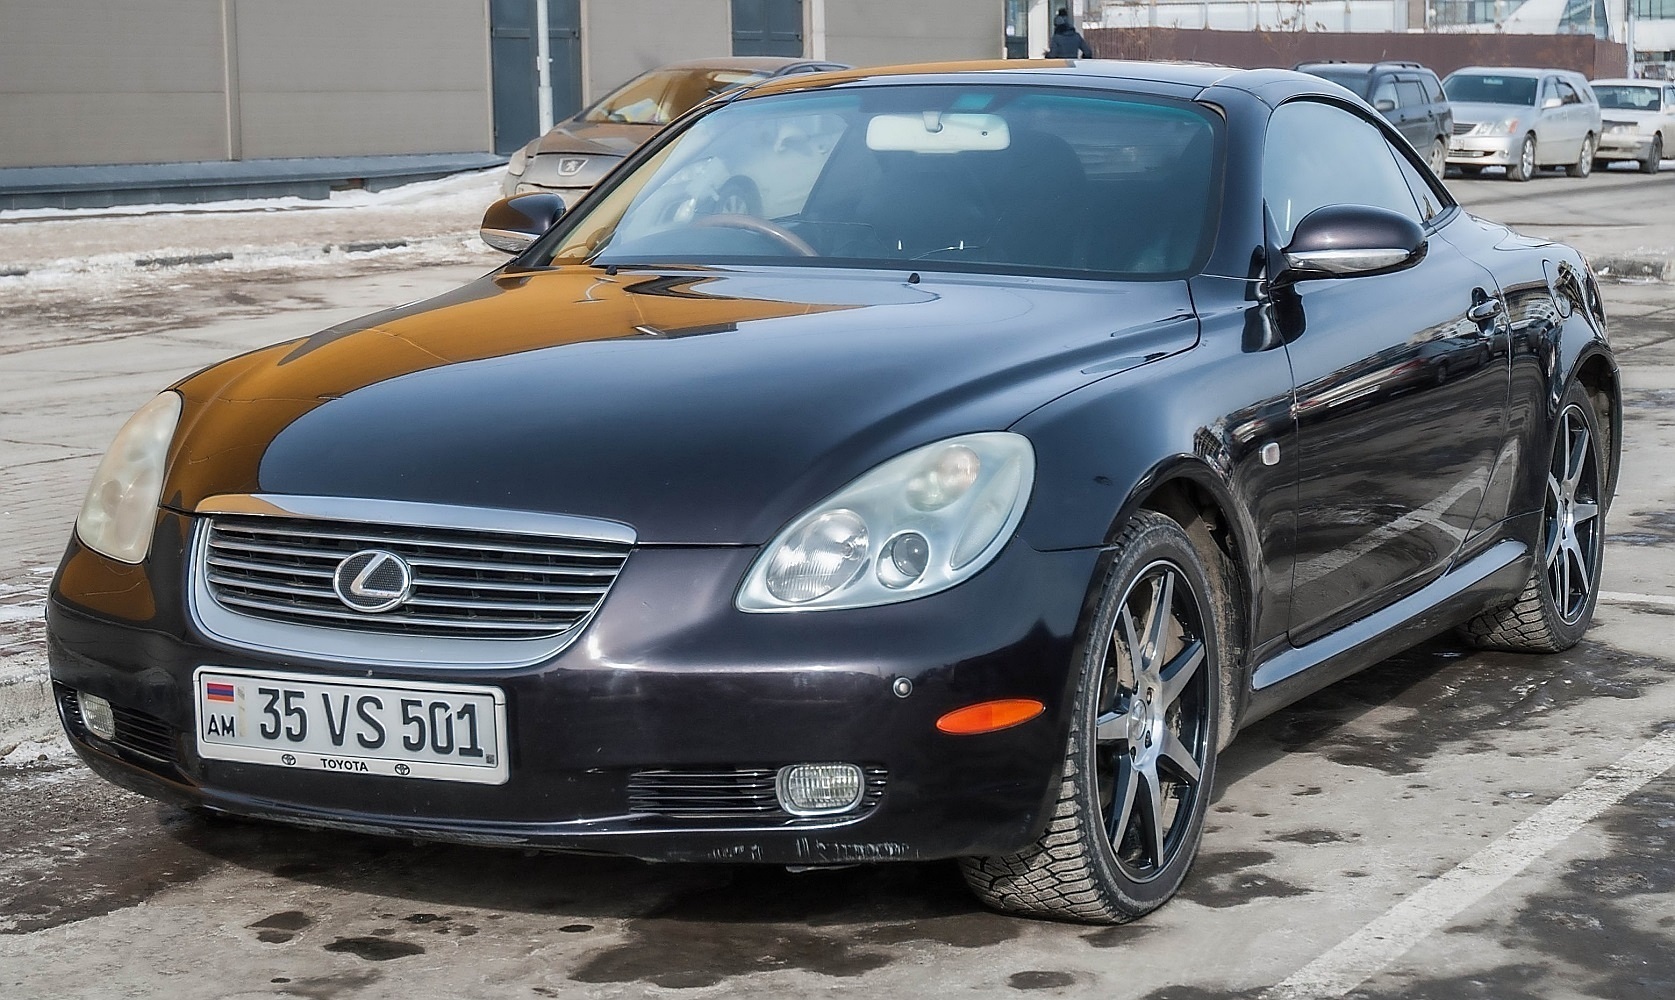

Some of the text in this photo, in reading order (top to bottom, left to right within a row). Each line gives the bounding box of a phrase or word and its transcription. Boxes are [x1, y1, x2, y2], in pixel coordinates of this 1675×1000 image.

[207, 714, 235, 738] AM
[258, 687, 484, 758] 35 VS 501
[320, 758, 369, 773] TOYOTA
